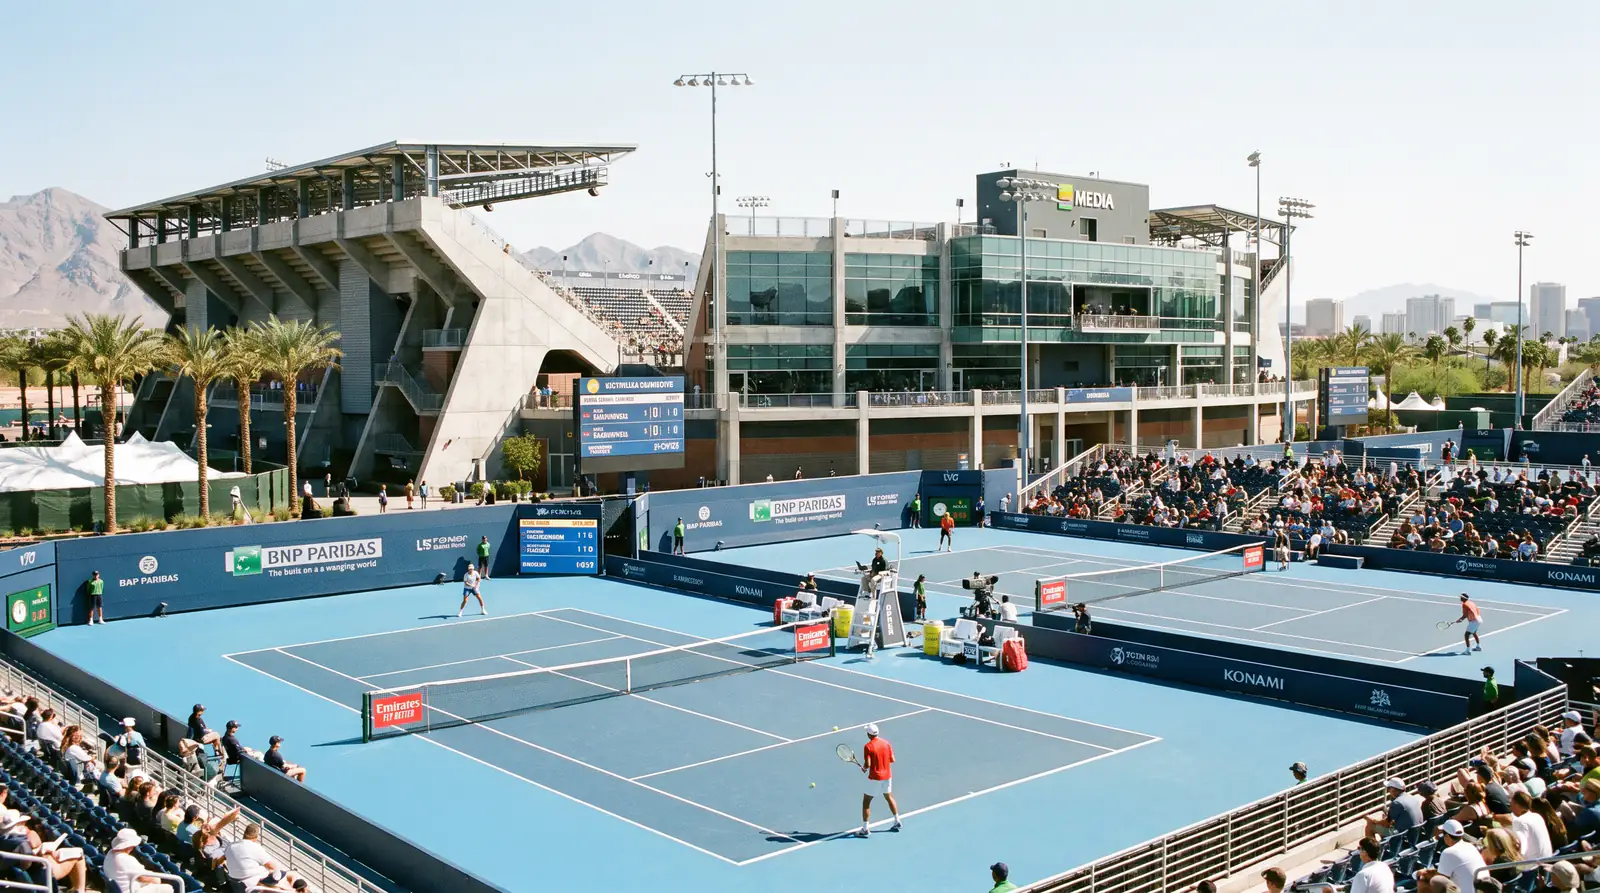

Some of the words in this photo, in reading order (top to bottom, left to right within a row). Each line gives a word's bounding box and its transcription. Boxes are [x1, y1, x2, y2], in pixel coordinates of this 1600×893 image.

[1075, 190, 1114, 209] MEDIA
[774, 502, 795, 514] BNP
[799, 497, 842, 511] PARIBAS
[699, 520, 723, 528] PARIBAS
[268, 549, 303, 565] BNP
[308, 541, 376, 561] PARIBAS
[356, 560, 377, 568] world
[119, 578, 139, 587] BAP
[141, 574, 179, 585] PARIBAS
[1547, 570, 1595, 583] KONAMI
[735, 585, 763, 598] KONAMI
[1224, 668, 1284, 690] KONAMI
[376, 699, 420, 714] Emirates
